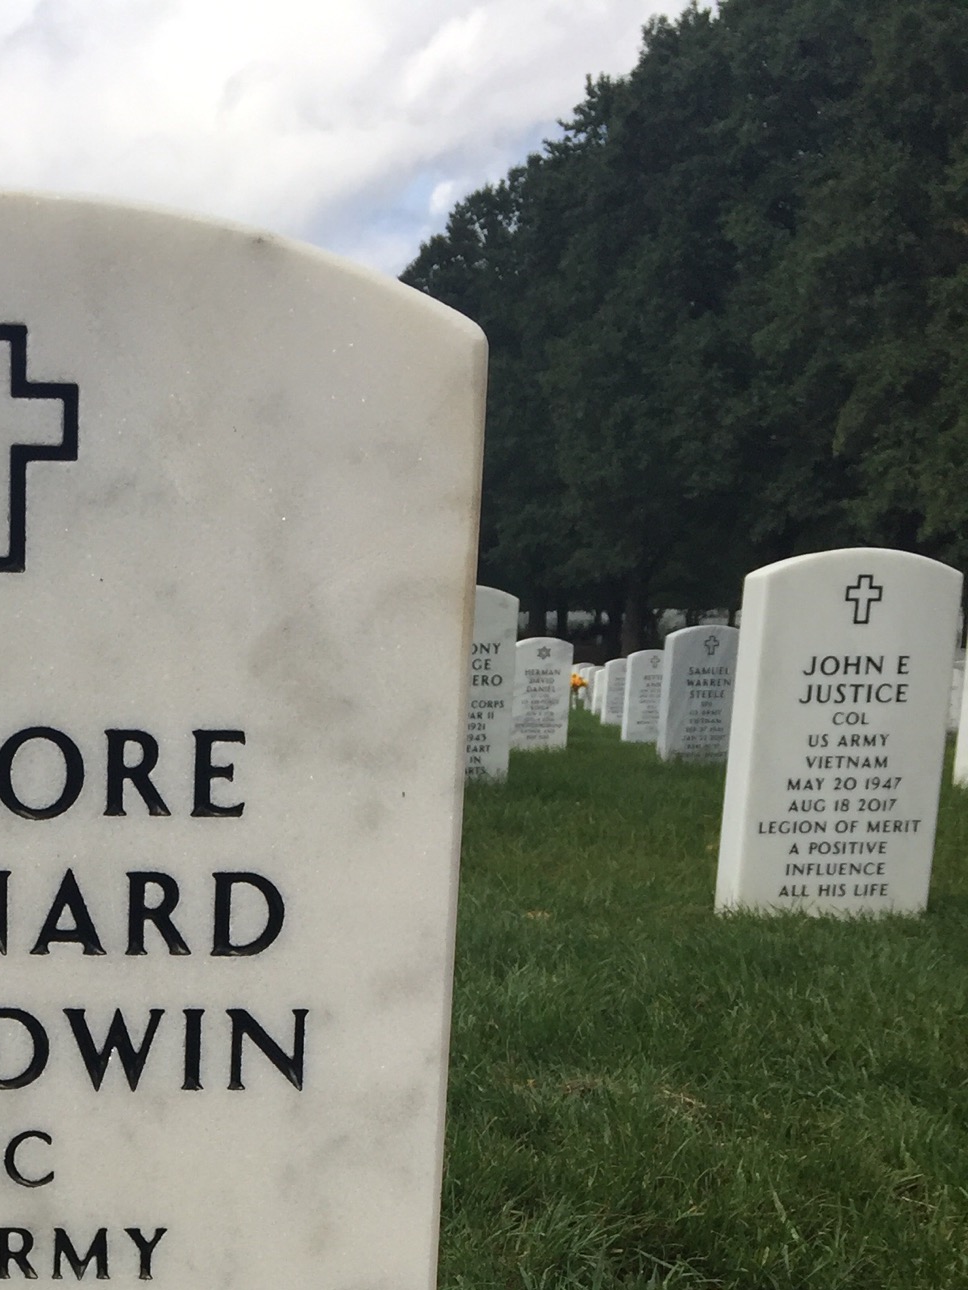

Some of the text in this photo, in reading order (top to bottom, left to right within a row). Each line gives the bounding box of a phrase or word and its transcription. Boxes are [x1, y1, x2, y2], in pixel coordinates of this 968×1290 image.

[689, 667, 729, 675] SAMUEL
[804, 656, 909, 675] JOHN E
[687, 679, 731, 687] WARREN
[690, 690, 725, 698] STEELE
[799, 684, 908, 704] JUSTICE
[471, 700, 504, 709] CORPS
[468, 712, 494, 720] AR II
[833, 712, 869, 725] COL
[809, 734, 889, 747] US ARMY
[467, 745, 490, 753] EART
[470, 755, 481, 763] IN
[806, 756, 887, 768] VIETNAM
[788, 777, 902, 790] MAY 20 1947
[788, 799, 897, 812] AUG 18 2017
[759, 820, 921, 834] LEGION OF MERIT
[789, 842, 887, 854] A POSITIVE
[786, 862, 885, 875] INFLUENCE
[779, 884, 888, 897] ALL HIS LIFE
